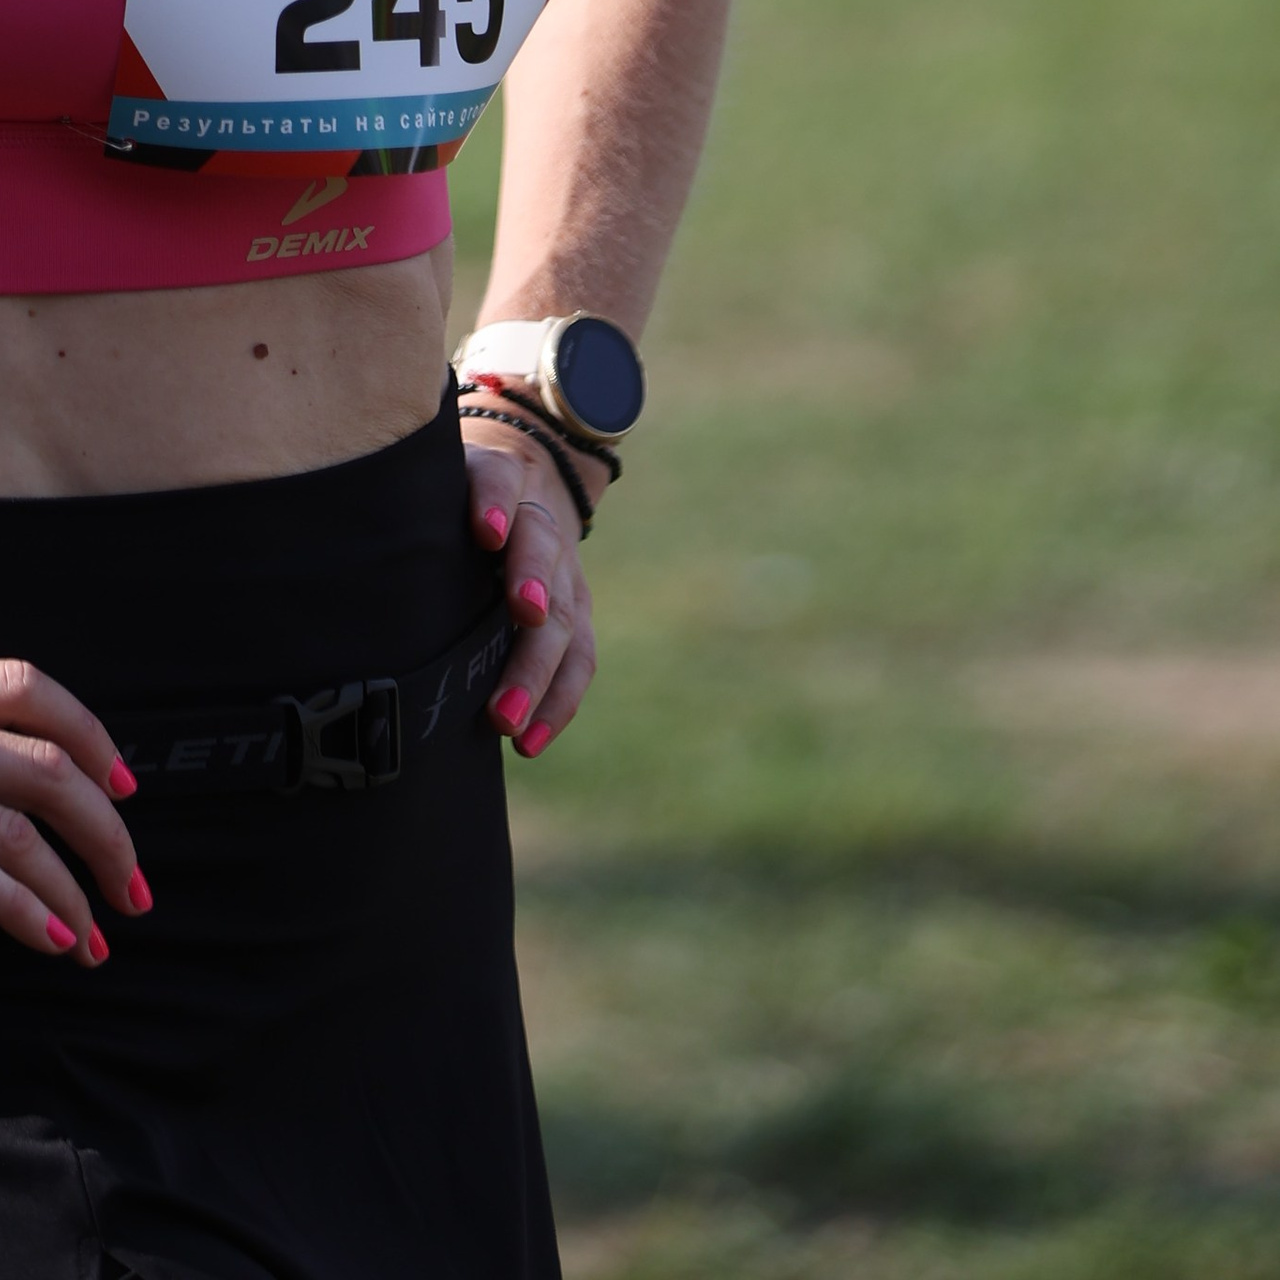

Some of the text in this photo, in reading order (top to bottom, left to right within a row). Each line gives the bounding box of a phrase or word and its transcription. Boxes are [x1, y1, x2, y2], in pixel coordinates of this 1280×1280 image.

[133, 110, 337, 137] Результаты
[356, 115, 385, 131] на
[400, 107, 454, 129] сайте
[246, 226, 375, 262] DEMIX
